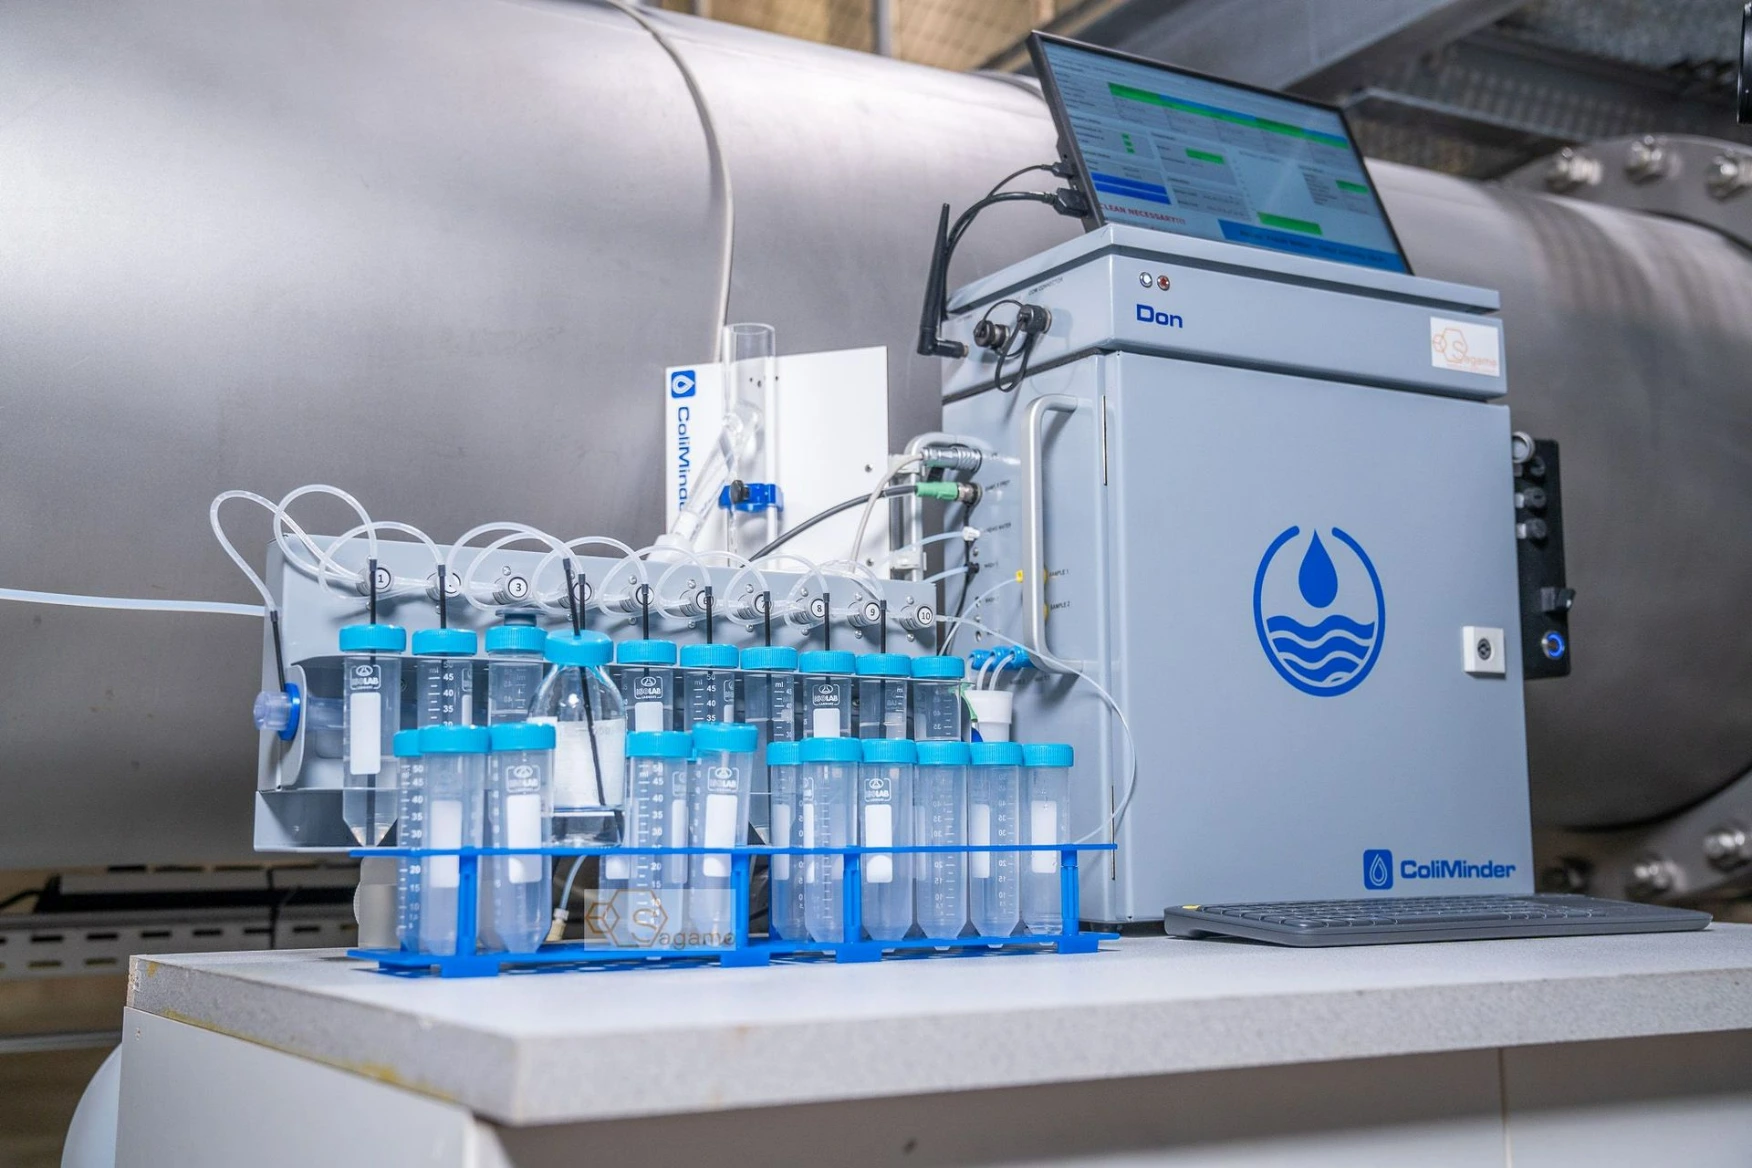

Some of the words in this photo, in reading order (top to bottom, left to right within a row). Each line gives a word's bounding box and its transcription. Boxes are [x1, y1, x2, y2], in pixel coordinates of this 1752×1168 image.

[1136, 304, 1183, 329] Don
[516, 583, 522, 592] 3
[816, 604, 822, 613] 8
[870, 608, 875, 616] 9
[921, 612, 931, 620] 10
[443, 672, 454, 681] 45
[706, 684, 717, 693] 45
[443, 689, 454, 698] 40
[706, 699, 717, 708] 40
[443, 704, 454, 713] 35
[706, 713, 717, 722] 35
[412, 764, 424, 774] 50
[412, 778, 424, 787] 45
[652, 777, 664, 786] 45
[411, 795, 424, 804] 40
[652, 794, 664, 803] 40
[411, 812, 423, 821] 35
[652, 810, 664, 819] 35
[410, 829, 422, 839] 30
[651, 827, 663, 837] 30
[409, 864, 421, 874] 20
[650, 861, 662, 871] 20
[1400, 859, 1516, 879] ColiMinder
[409, 883, 420, 892] 15
[651, 880, 661, 889] 15
